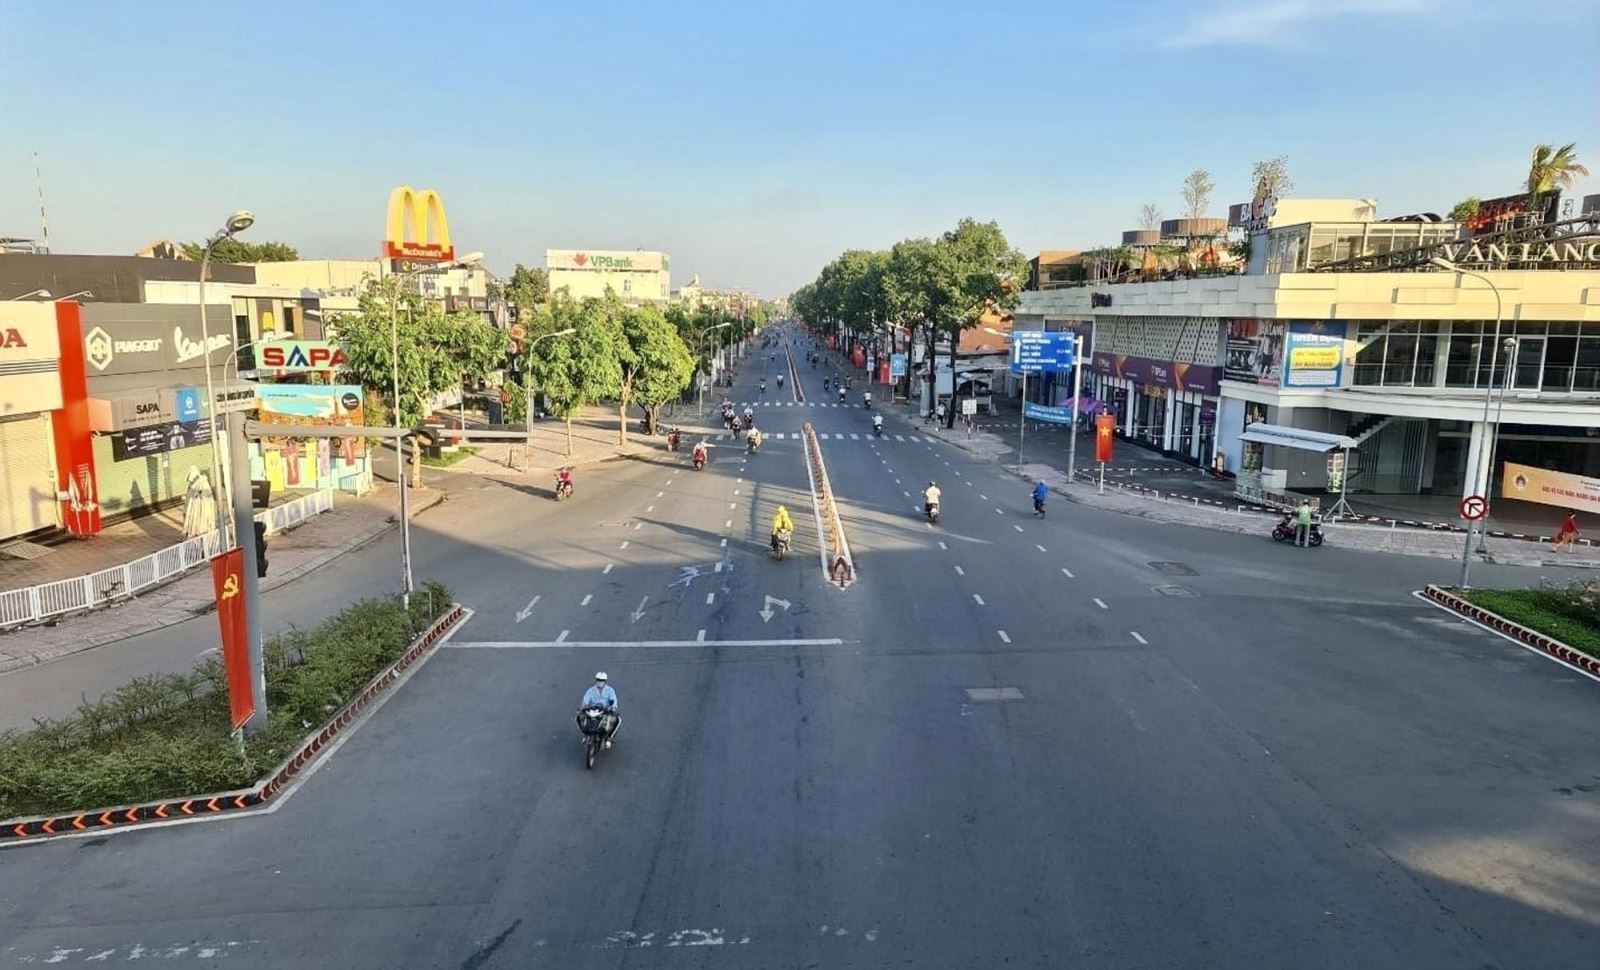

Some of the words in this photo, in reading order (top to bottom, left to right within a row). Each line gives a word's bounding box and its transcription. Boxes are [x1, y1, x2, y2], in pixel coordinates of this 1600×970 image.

[402, 247, 442, 258] McDonald's
[590, 255, 633, 267] VPBank
[1444, 238, 1509, 262] VĂN
[173, 325, 232, 364] Vespa
[263, 345, 349, 367] SAPA
